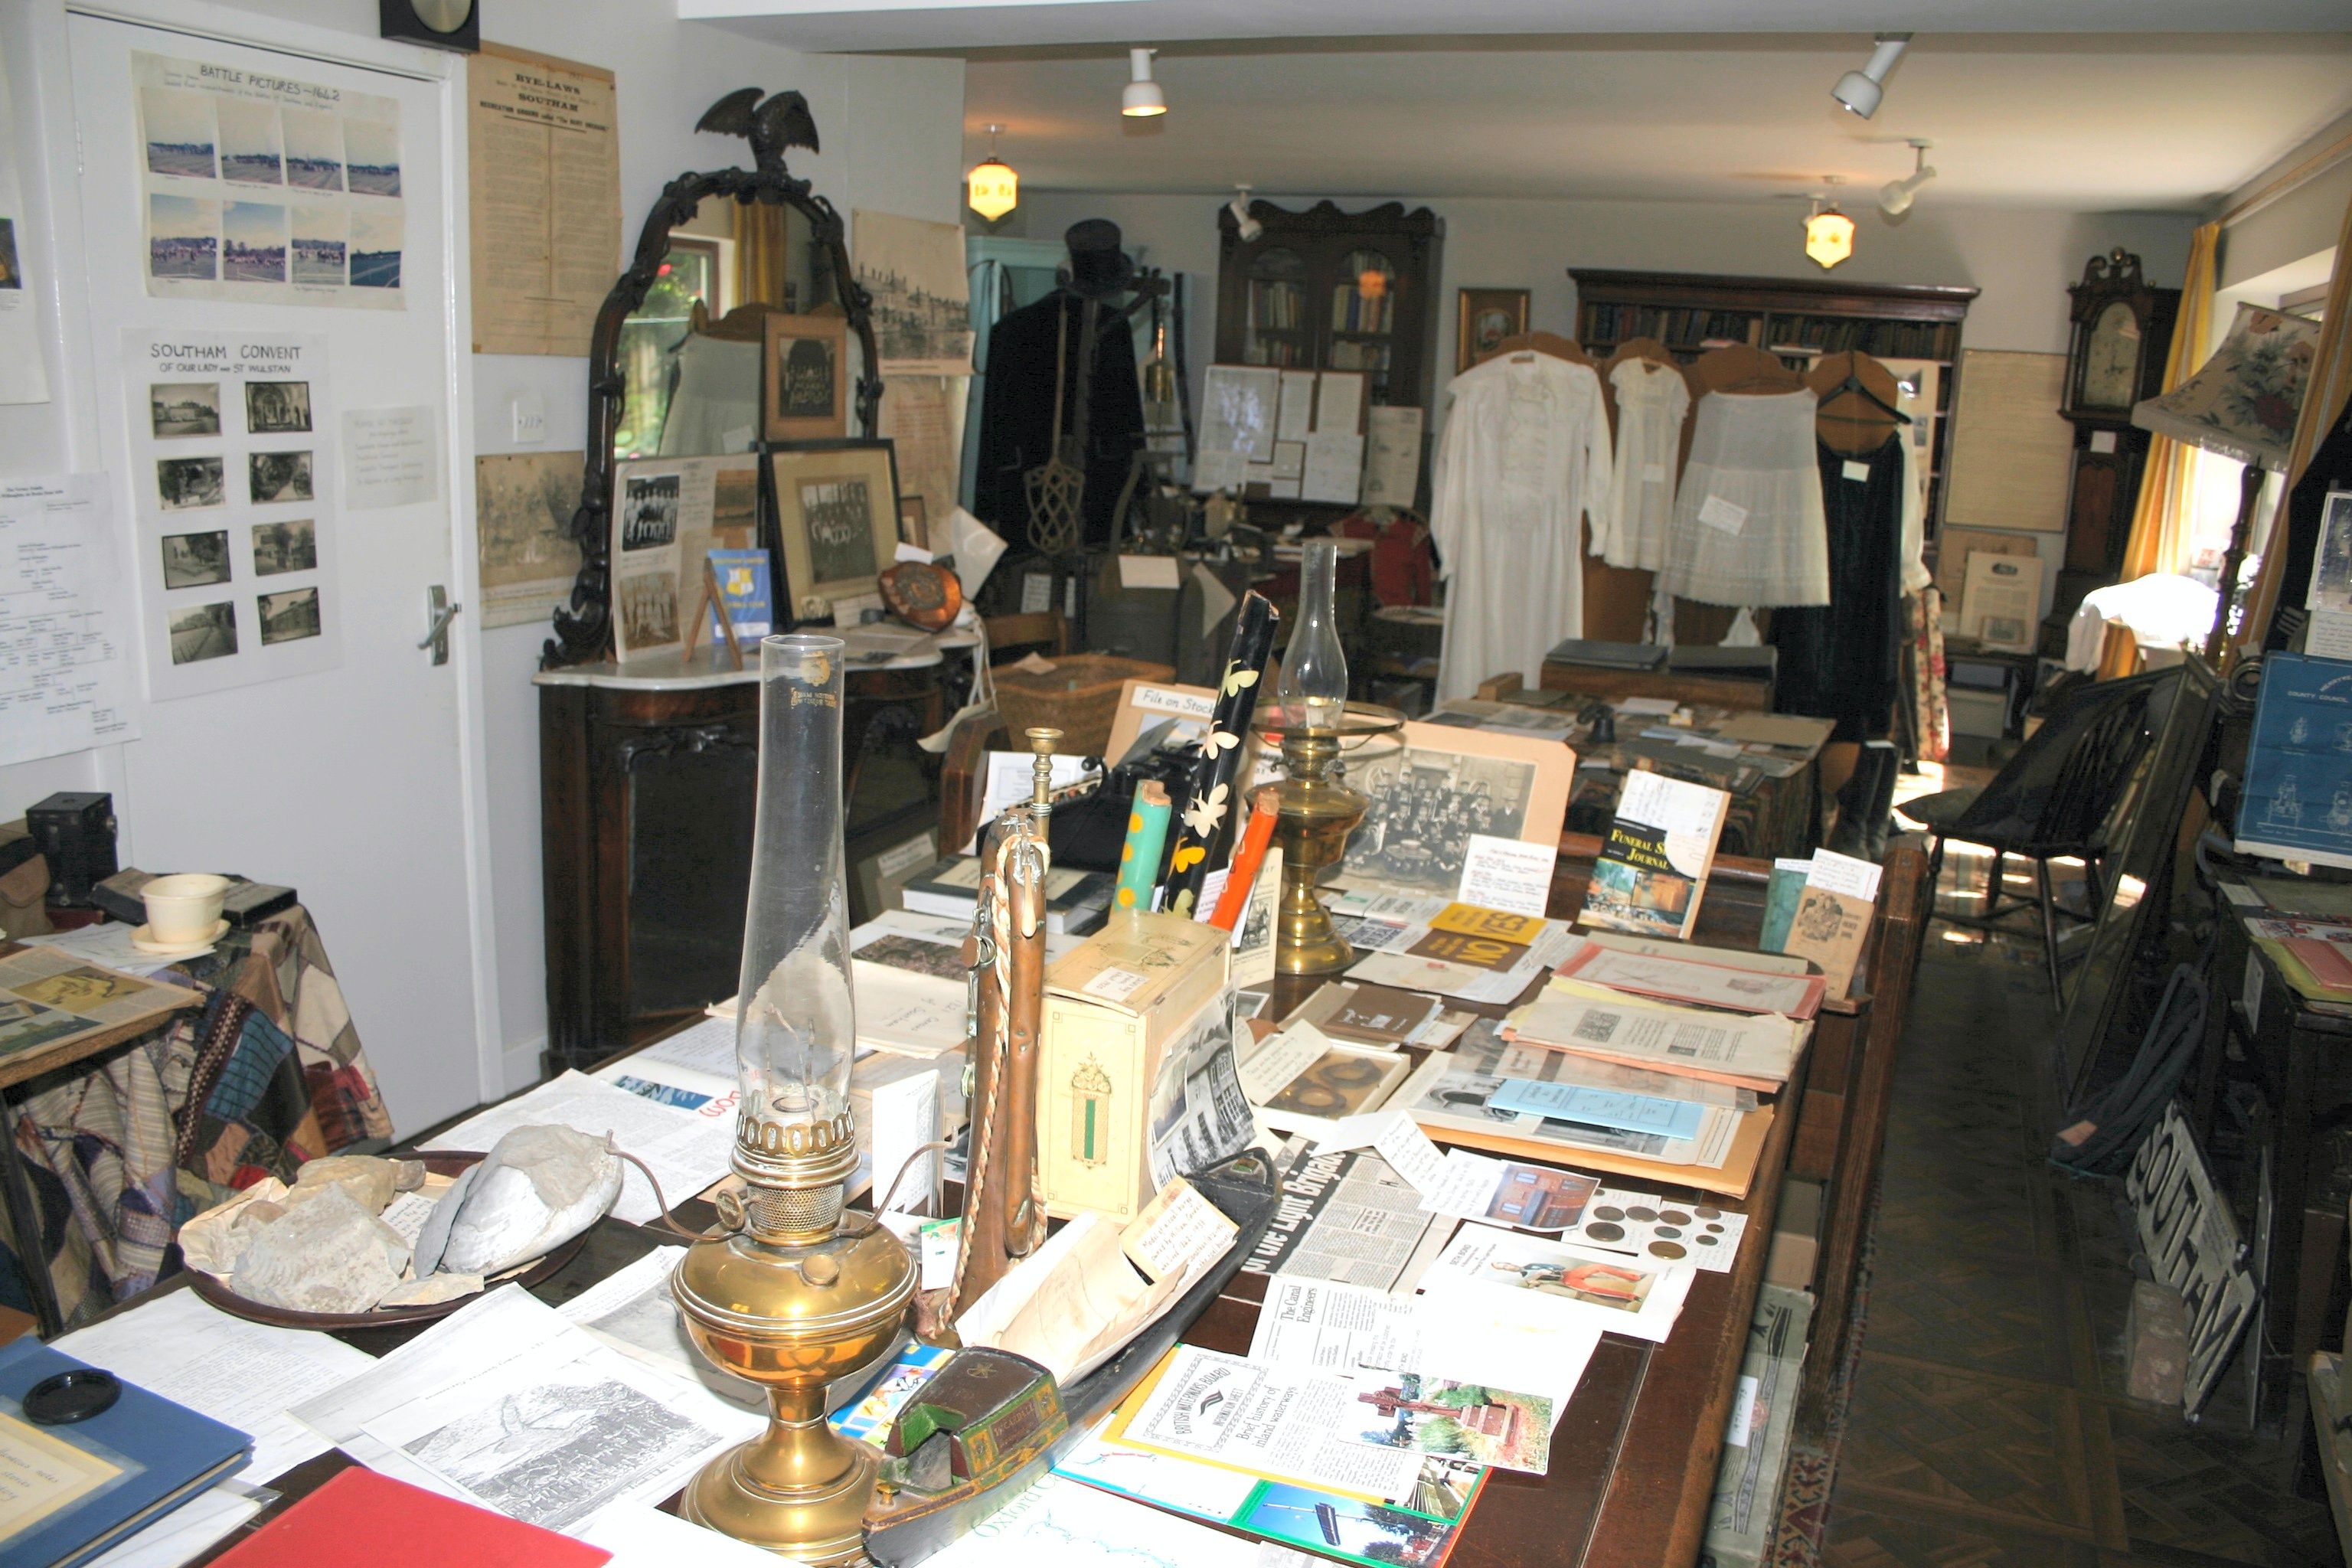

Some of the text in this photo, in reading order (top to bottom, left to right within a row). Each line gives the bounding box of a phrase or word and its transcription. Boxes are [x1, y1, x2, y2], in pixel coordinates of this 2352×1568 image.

[201, 64, 242, 83] BATTLE
[250, 75, 301, 96] PICTURES
[518, 92, 579, 112] SOUTHAM
[151, 343, 302, 360] SOUTHAM CONVENT
[159, 363, 173, 372] OF
[176, 363, 197, 373] OUR
[197, 364, 218, 374] LADY
[247, 364, 292, 374] WULSTAN
[1142, 689, 1162, 705] File
[1165, 695, 1180, 709] on
[1610, 828, 1653, 853] FUNERAL
[1625, 847, 1669, 871] JOURNAL
[1475, 911, 1530, 937] YES
[1455, 939, 1511, 965] NO
[1280, 1285, 1302, 1321] The Canal
[1296, 1288, 1318, 1324] Engineers
[1173, 1367, 1231, 1435] BRITISH WATERWAYS BOARD
[1213, 1399, 1234, 1427] INFORMATION
[1236, 1384, 1281, 1440] Brief history of
[1252, 1386, 1298, 1448] inland waterways
